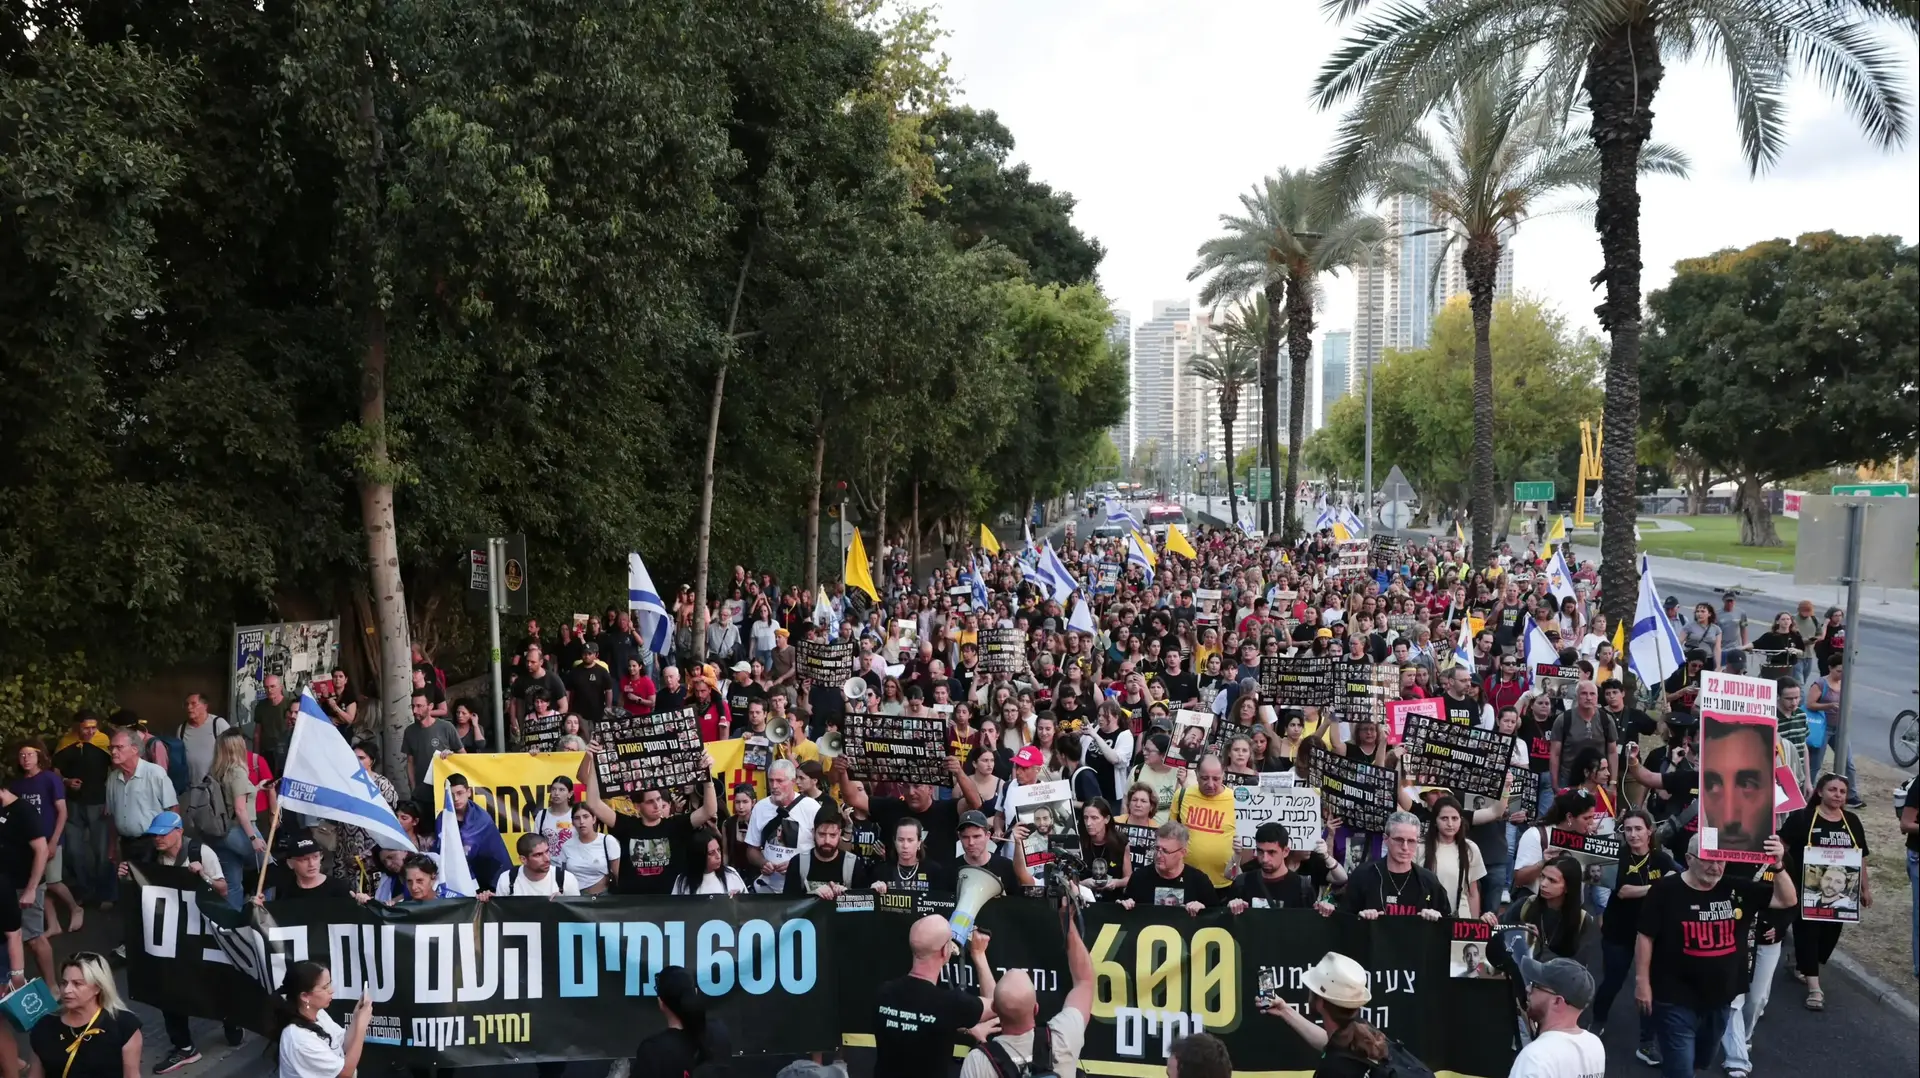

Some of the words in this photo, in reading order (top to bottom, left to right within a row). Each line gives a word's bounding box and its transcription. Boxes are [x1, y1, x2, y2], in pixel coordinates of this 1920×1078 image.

[240, 632, 261, 643] מנהיג
[241, 641, 260, 655] אמיץ
[1708, 678, 1719, 693] 22
[1756, 684, 1772, 700] מתן
[1397, 705, 1422, 713] LEAVE
[1732, 701, 1745, 712] אינו
[617, 742, 644, 755] האחרון
[643, 740, 668, 752] החטוף
[667, 739, 679, 749] עד
[865, 741, 890, 753] האחרון
[890, 744, 914, 755] החטוף
[914, 746, 925, 755] עד
[1425, 743, 1450, 757] האחרון
[1450, 749, 1474, 762] החטוף
[1475, 755, 1485, 765] עד
[1323, 775, 1343, 792] האחרון
[1343, 784, 1363, 798] החטוף
[1364, 791, 1374, 802] עד
[1248, 793, 1266, 806] לא
[1284, 796, 1316, 809] נקמה
[1187, 805, 1225, 829] NOW
[858, 831, 875, 843] למה
[1552, 830, 1584, 848] הצילו!
[1584, 842, 1619, 856] זועקים
[880, 894, 912, 908] חסמבה
[923, 900, 955, 908] אוניברסיטת
[1699, 911, 1719, 920] הביתה
[1454, 921, 1490, 940] הצילו!
[1681, 919, 1736, 948] עכשיו
[328, 923, 396, 1002] עם
[414, 921, 543, 1003] העם
[558, 920, 685, 998] ימים
[697, 917, 817, 996] 600
[1090, 924, 1236, 1028] 600
[899, 1009, 918, 1021] מקום
[920, 1012, 937, 1024] לכל
[468, 1012, 531, 1045] נחזיר.
[886, 1019, 899, 1029] מתן
[900, 1022, 919, 1032] איתך
[406, 1015, 465, 1052] נקום.
[1115, 1006, 1204, 1058] ימים
